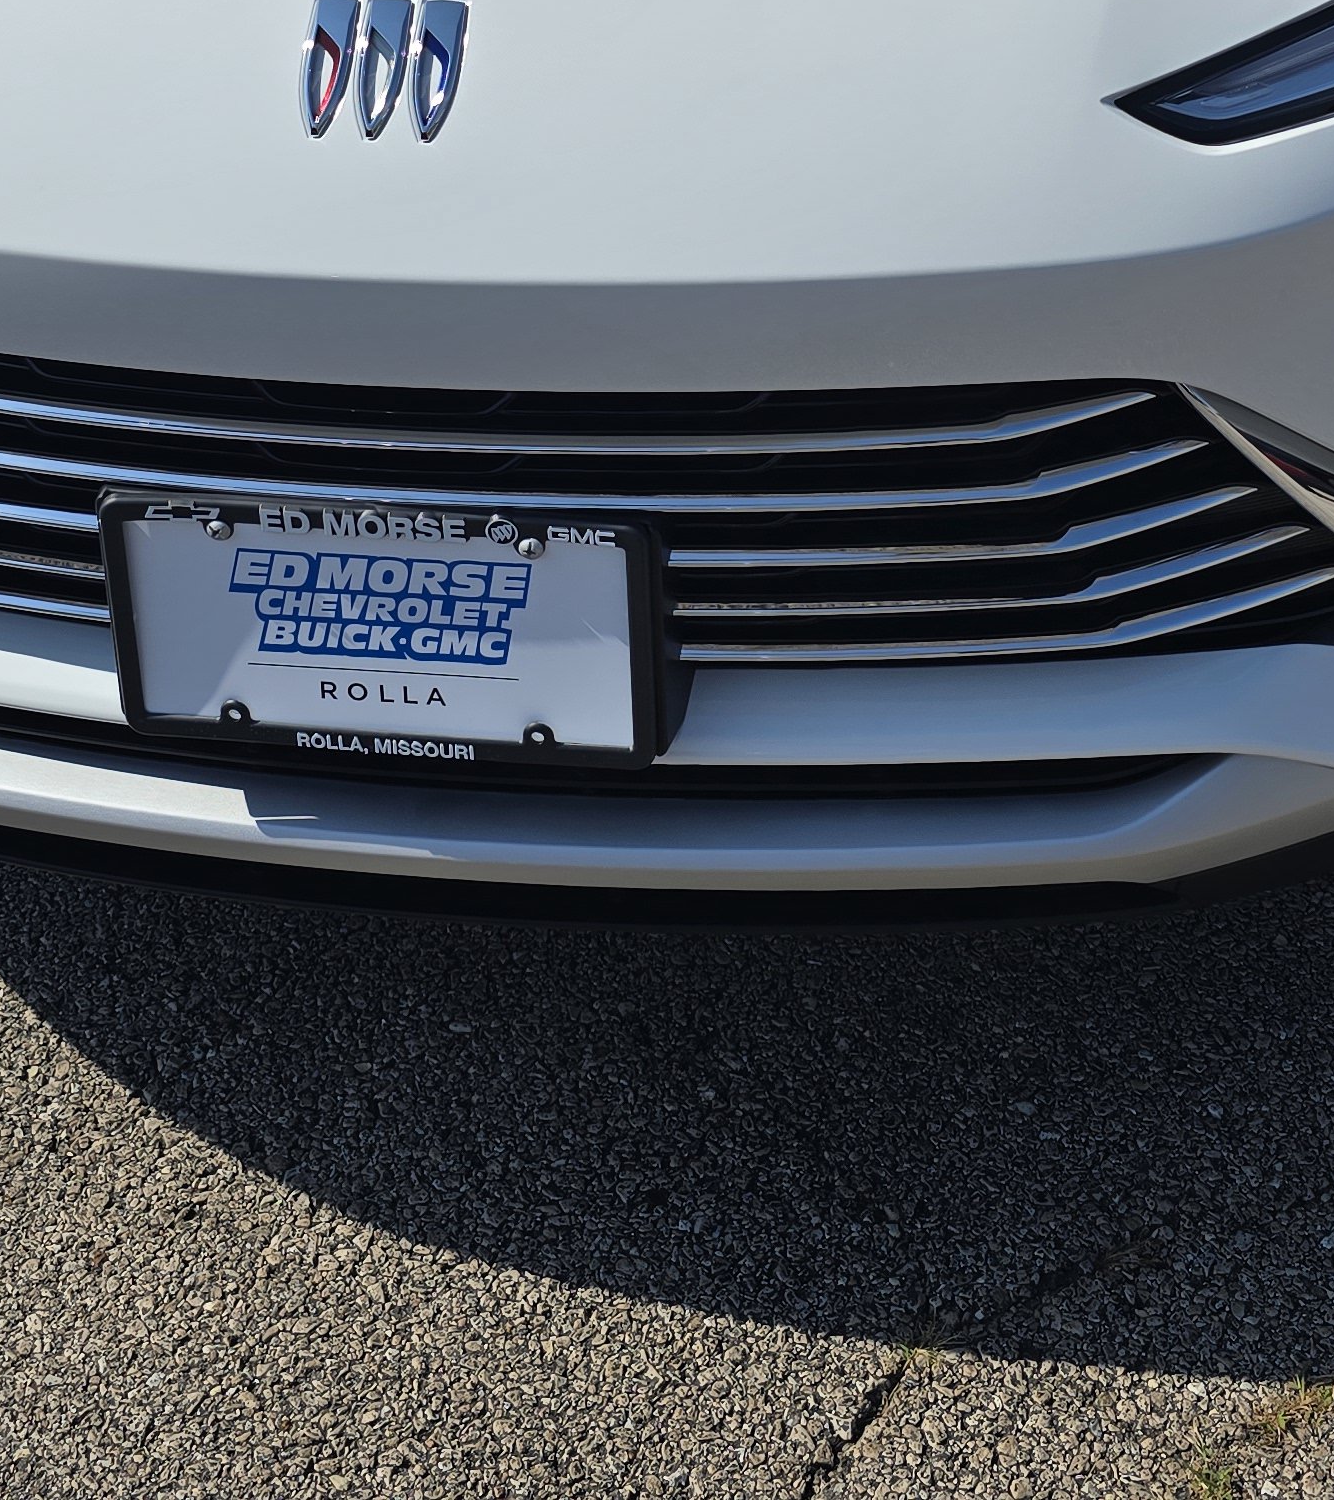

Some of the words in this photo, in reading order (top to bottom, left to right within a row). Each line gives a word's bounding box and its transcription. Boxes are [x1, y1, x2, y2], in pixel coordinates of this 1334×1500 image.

[259, 502, 310, 534] ED
[323, 508, 467, 544] MORSE
[547, 526, 616, 547] GMC
[232, 551, 310, 588] ED
[315, 555, 528, 600] MORSE
[258, 588, 507, 627] CHEVROLET
[320, 681, 446, 706] ROLLA
[296, 731, 369, 755] ROLLA,
[374, 737, 475, 760] MISSOURI
